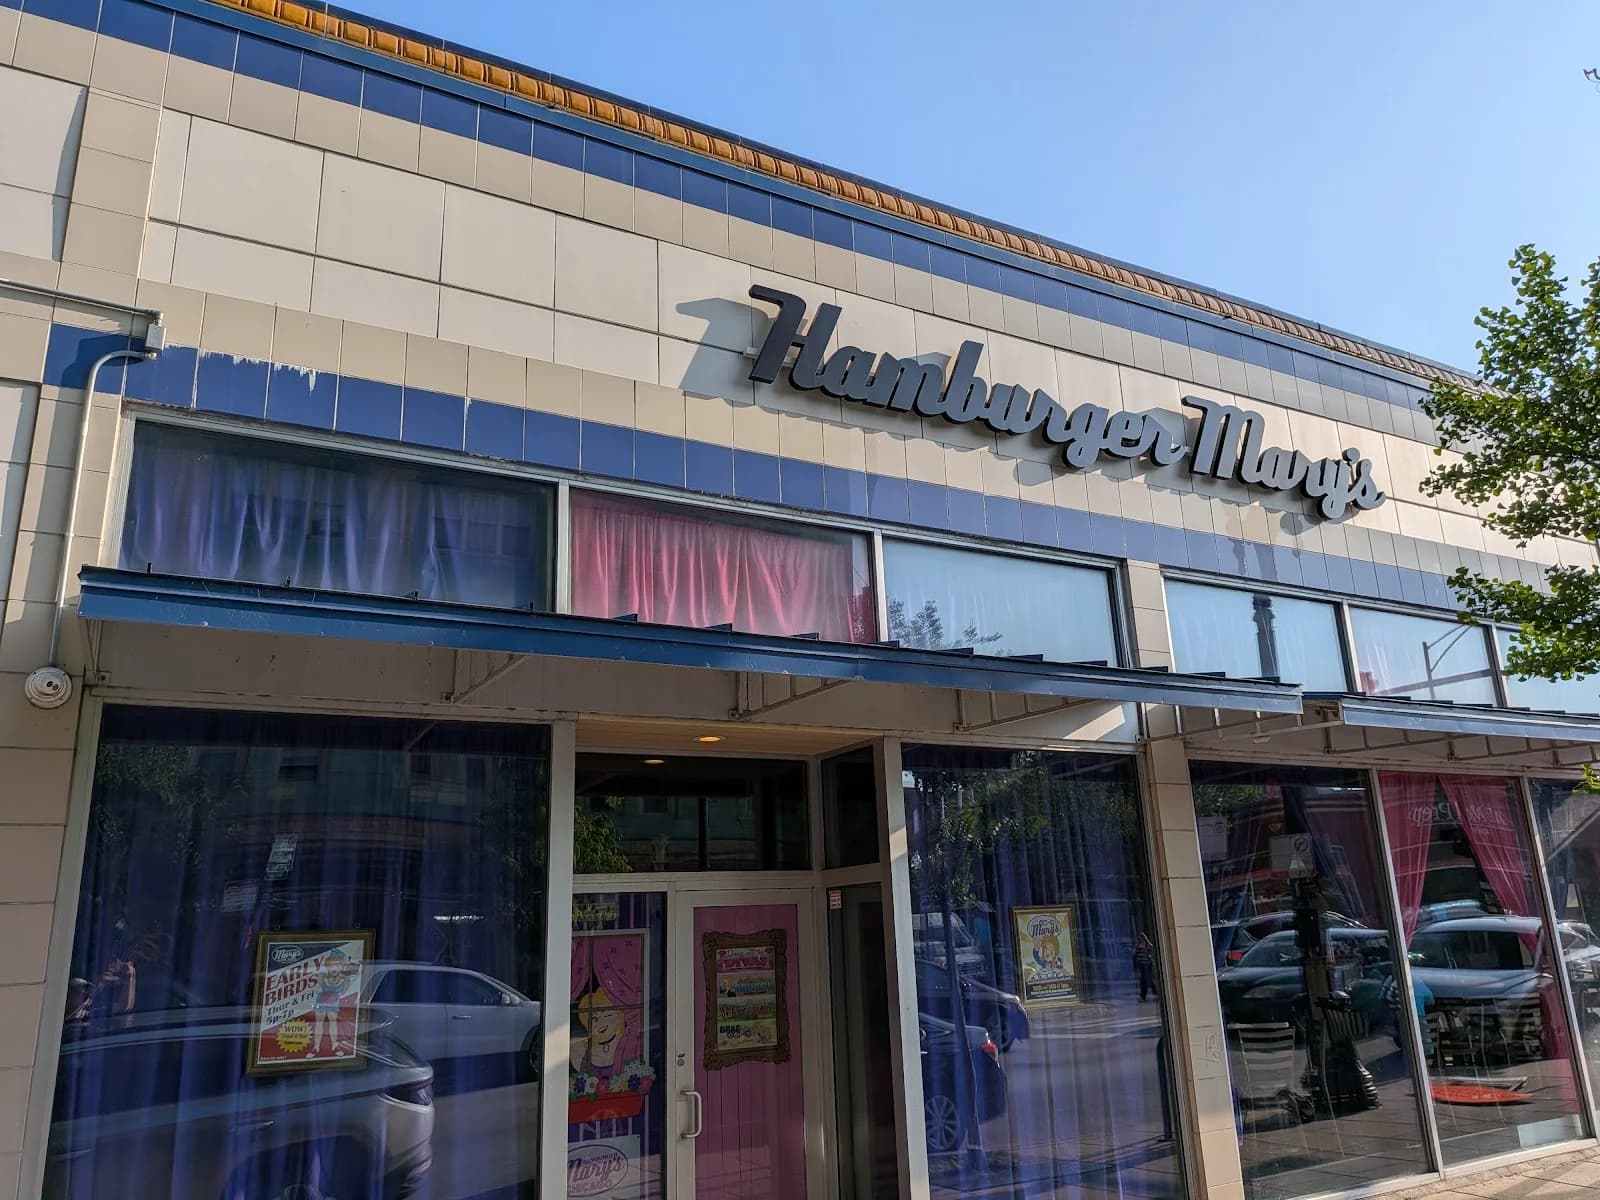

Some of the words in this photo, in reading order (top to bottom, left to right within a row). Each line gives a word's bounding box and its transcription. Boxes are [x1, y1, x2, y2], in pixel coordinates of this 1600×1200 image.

[748, 284, 1186, 470] Hamburger
[1182, 394, 1386, 521] Mary's
[265, 955, 325, 992] EARLY
[265, 972, 319, 1007] BIRDS
[267, 1002, 290, 1016] Thur
